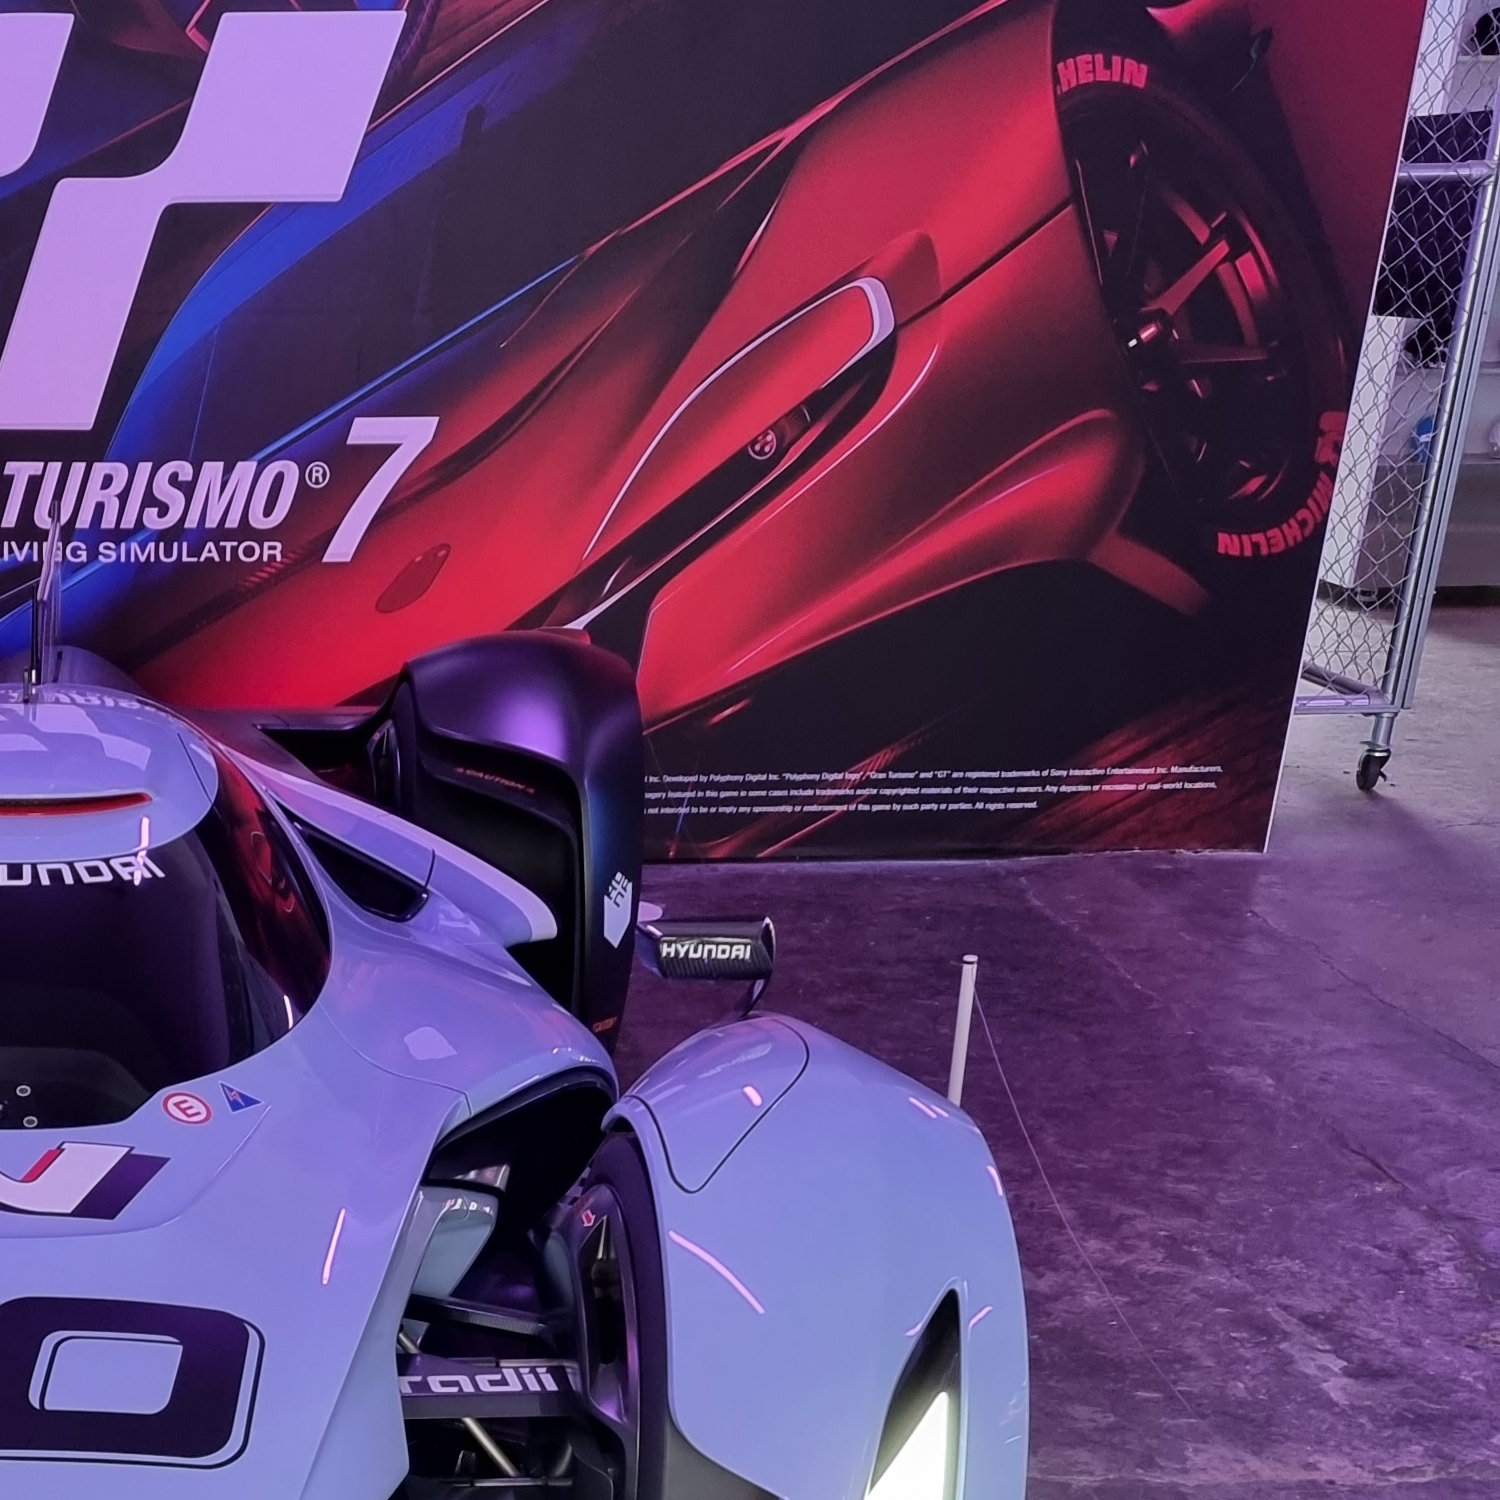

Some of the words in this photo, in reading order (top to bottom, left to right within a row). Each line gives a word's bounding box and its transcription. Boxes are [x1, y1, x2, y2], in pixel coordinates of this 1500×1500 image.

[321, 415, 441, 563] 7
[1217, 471, 1333, 557] MICHELIN
[98, 540, 283, 563] SIMULATOR
[661, 942, 751, 960] HYUNDAI
[398, 1367, 559, 1394] radii
